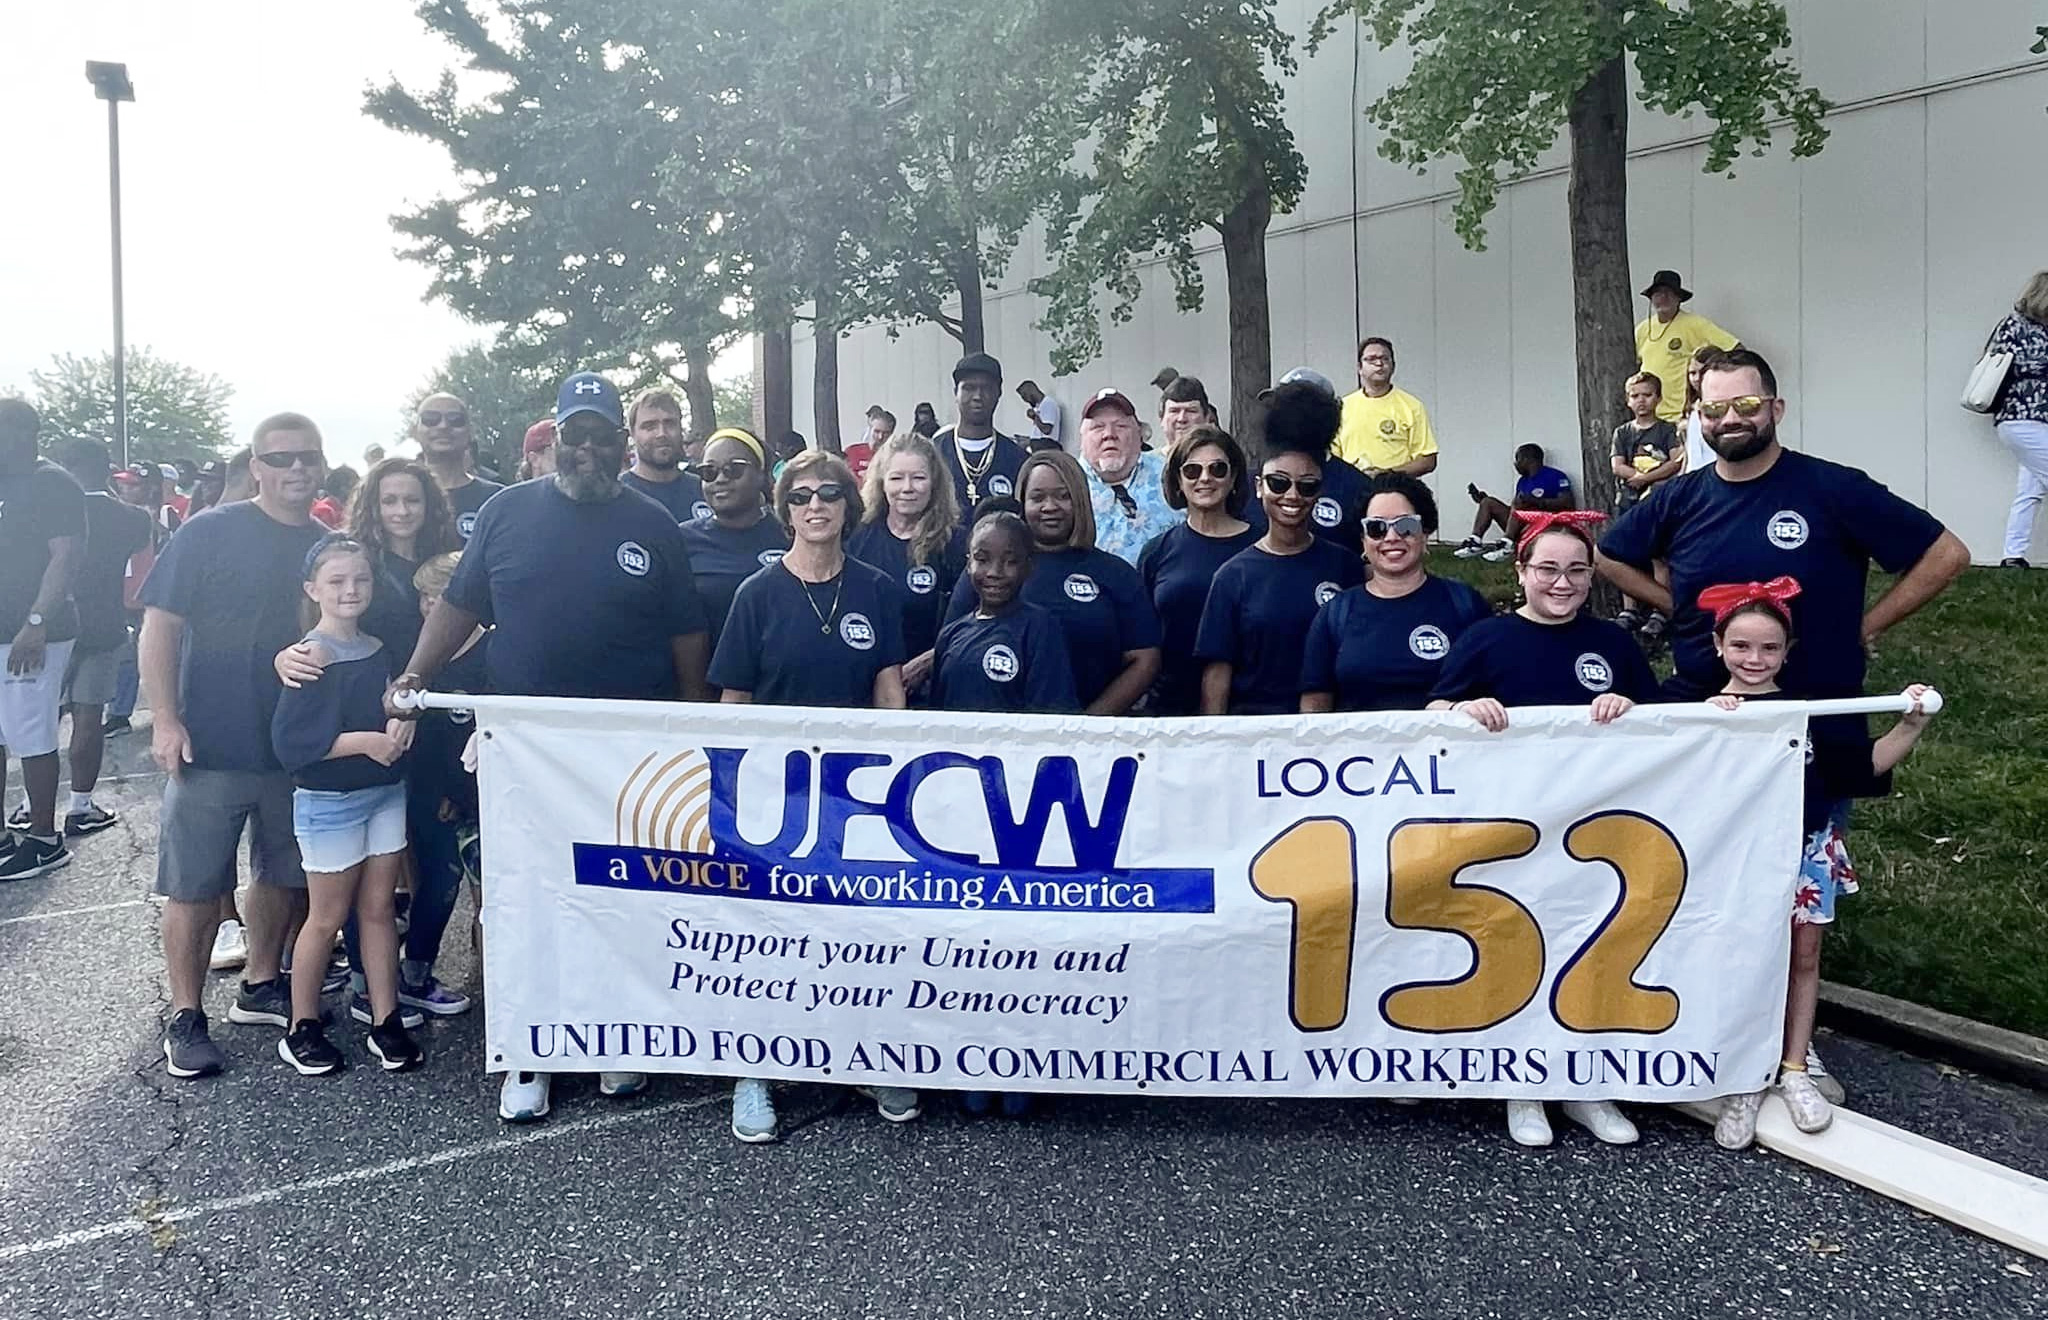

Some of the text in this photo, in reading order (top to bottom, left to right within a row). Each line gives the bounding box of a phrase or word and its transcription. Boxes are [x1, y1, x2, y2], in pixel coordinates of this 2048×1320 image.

[1774, 526, 1801, 538] 152
[624, 554, 645, 569] 152
[913, 575, 931, 585] 152
[1071, 584, 1093, 594] 152
[848, 627, 871, 639] 152
[1417, 639, 1443, 650] 152
[989, 658, 1012, 673] 152
[1583, 667, 1607, 681] 152
[1256, 755, 1456, 798] LOCAL
[702, 747, 1138, 868] UFCW
[608, 855, 1155, 910] a VOICE for working America
[1249, 809, 1689, 1034] 152
[666, 918, 1131, 973] Support your Union and
[669, 961, 1129, 1024] Protect your Democracy
[528, 1023, 1721, 1087] UNITED FOOD AND COMMERCIAL WORKERS UNION
